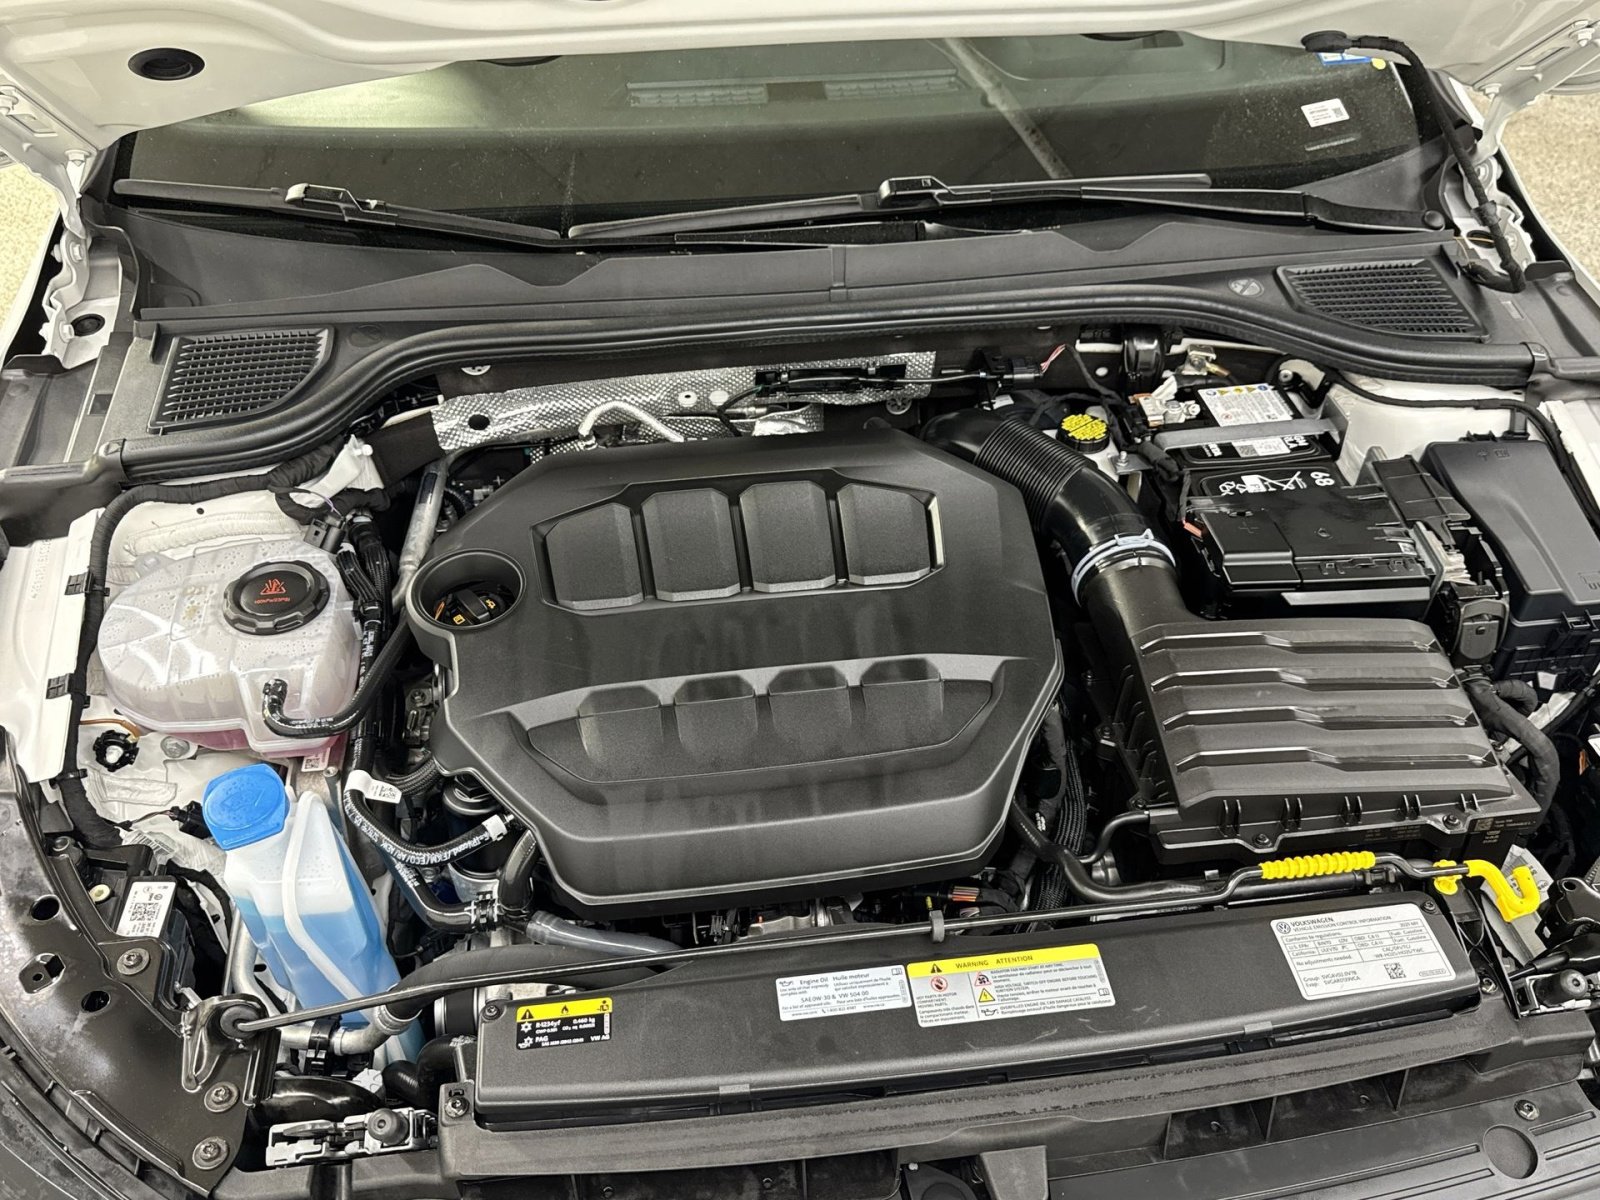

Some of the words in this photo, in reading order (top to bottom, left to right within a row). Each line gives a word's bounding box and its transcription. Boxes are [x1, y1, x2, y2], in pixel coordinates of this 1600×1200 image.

[1310, 471, 1335, 487] 68
[1290, 917, 1334, 927] VOLKSWAGEN
[955, 960, 989, 969] WARNING
[996, 955, 1033, 964] ATTENTION
[800, 978, 819, 986] Engine
[536, 1020, 561, 1029] R-1234yf
